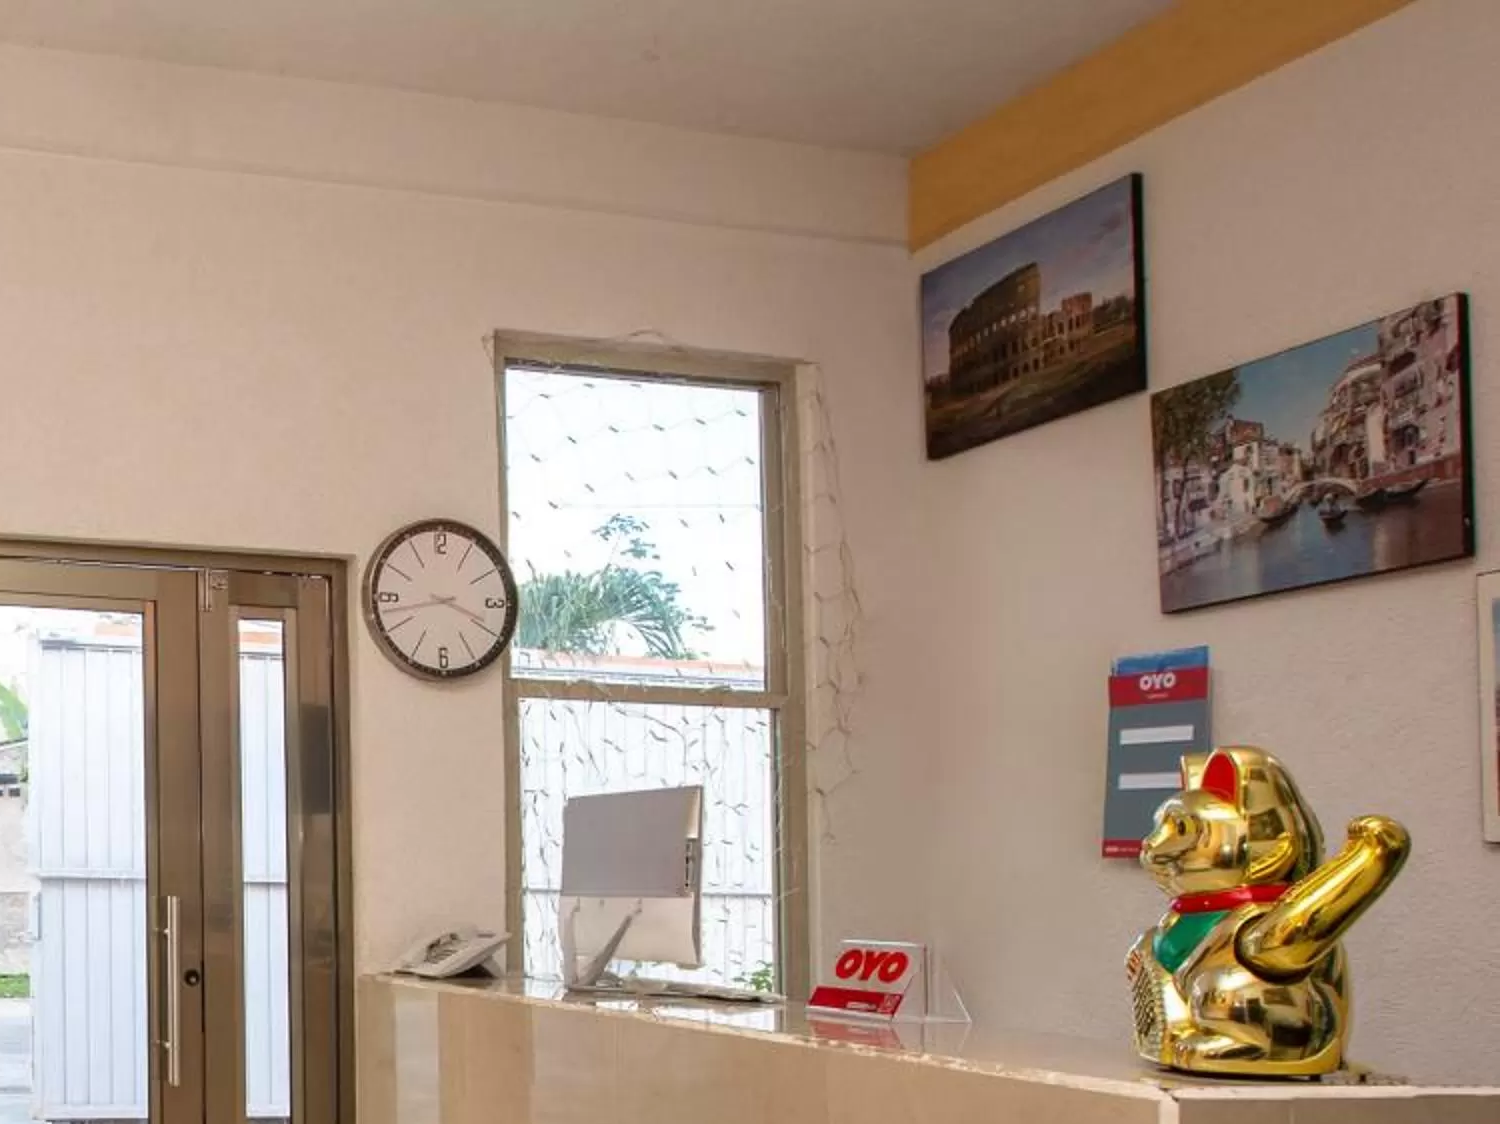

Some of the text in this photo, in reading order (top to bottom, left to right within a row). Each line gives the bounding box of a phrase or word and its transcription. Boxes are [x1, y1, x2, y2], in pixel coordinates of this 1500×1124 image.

[485, 597, 505, 609] 3
[438, 647, 449, 669] 6
[1139, 672, 1177, 691] OYO
[835, 949, 909, 984] OYO
